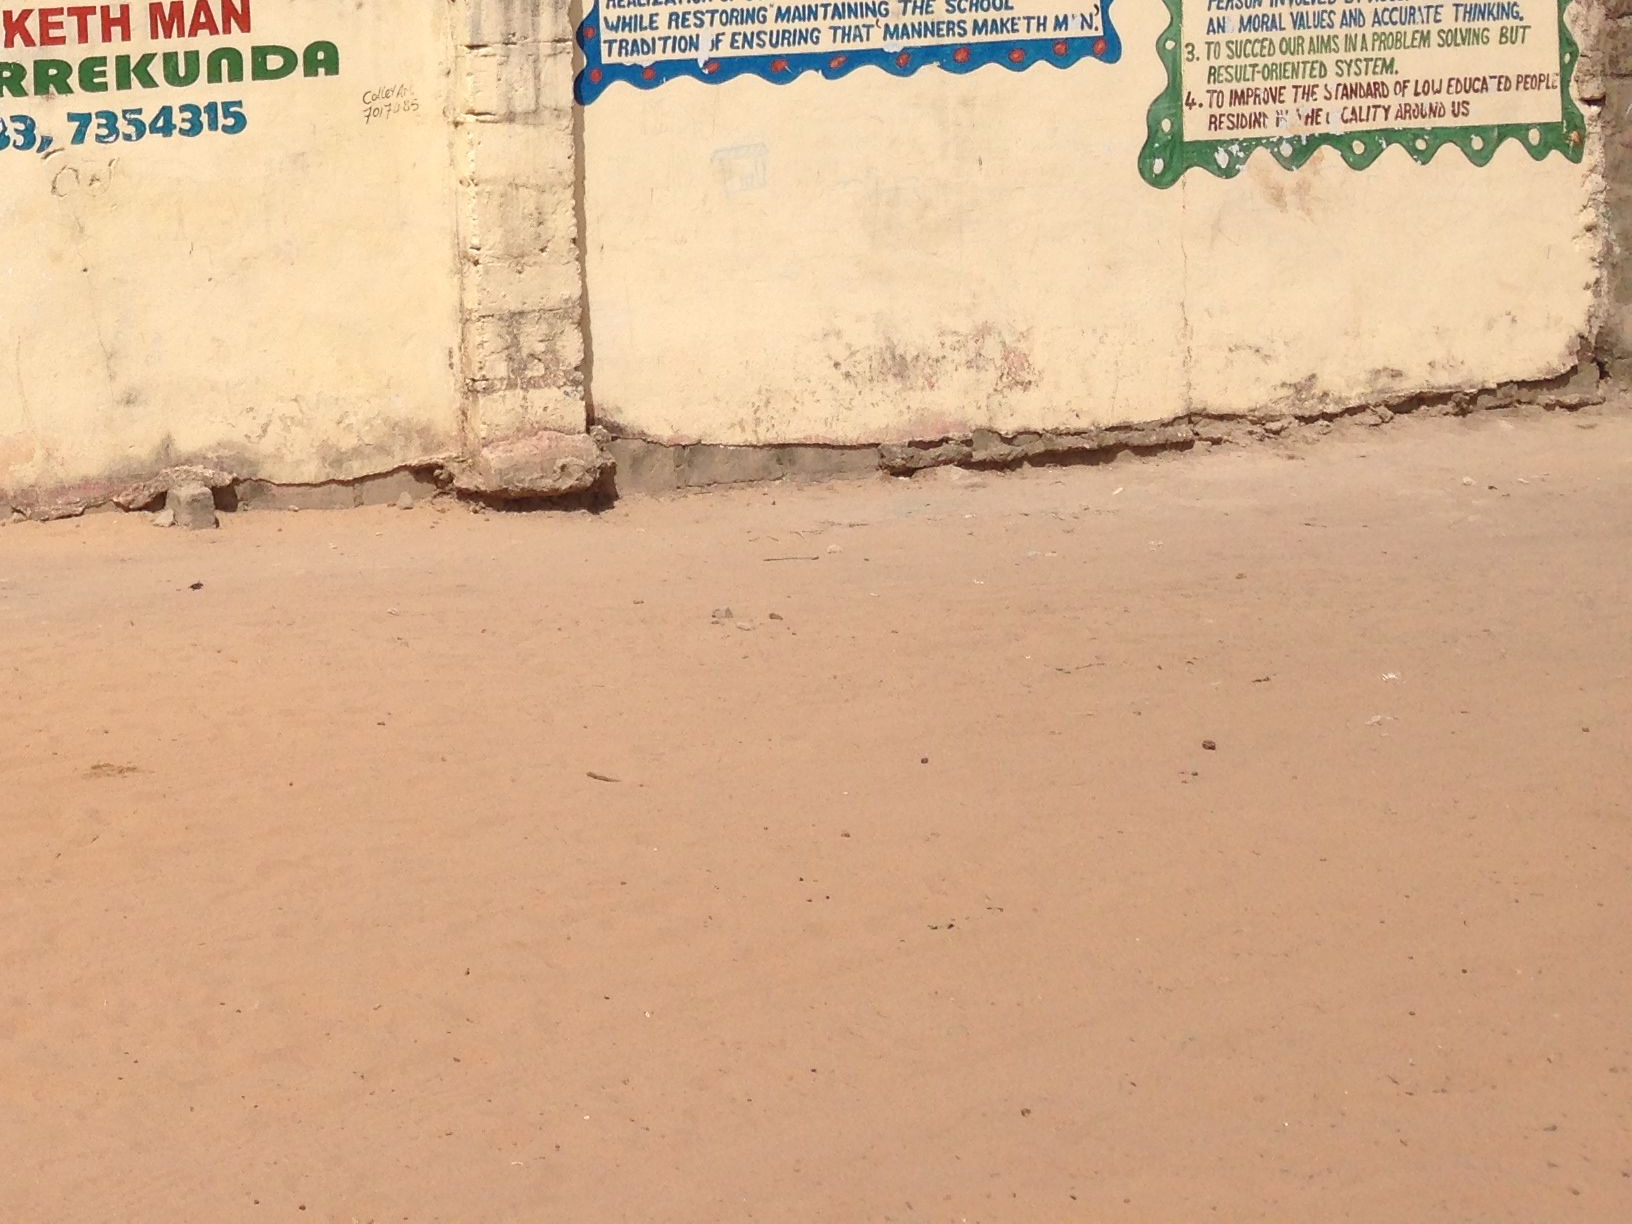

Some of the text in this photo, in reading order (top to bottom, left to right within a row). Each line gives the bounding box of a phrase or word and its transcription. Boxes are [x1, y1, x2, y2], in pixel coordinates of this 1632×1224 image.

[603, 12, 659, 34] WHILE
[668, 6, 768, 30] RESTORING
[1207, 16, 1229, 35] AN
[1238, 13, 1286, 33] MORAL
[1290, 10, 1336, 30] VALUES
[1340, 8, 1365, 28] AND
[1453, 2, 1524, 22] THINKING.
[603, 34, 699, 58] TRADITION
[729, 27, 821, 50] ENSURING
[829, 24, 874, 42] THAT
[1185, 25, 1531, 62] 3. TO SUCCED OUR AIMS IN A PROBLEM SOLVING BUT
[1207, 57, 1399, 84] RESULT-ORIENTED SYSTEM.
[1185, 91, 1203, 110] 4.
[1206, 89, 1224, 108] TO
[1229, 86, 1286, 107] IMPROVE
[1292, 84, 1319, 103] THE
[1324, 80, 1389, 101] STANDARD
[1394, 79, 1410, 97] OF
[1413, 79, 1443, 96] LOW
[1451, 100, 1470, 118] US
[67, 100, 248, 146] 7354315
